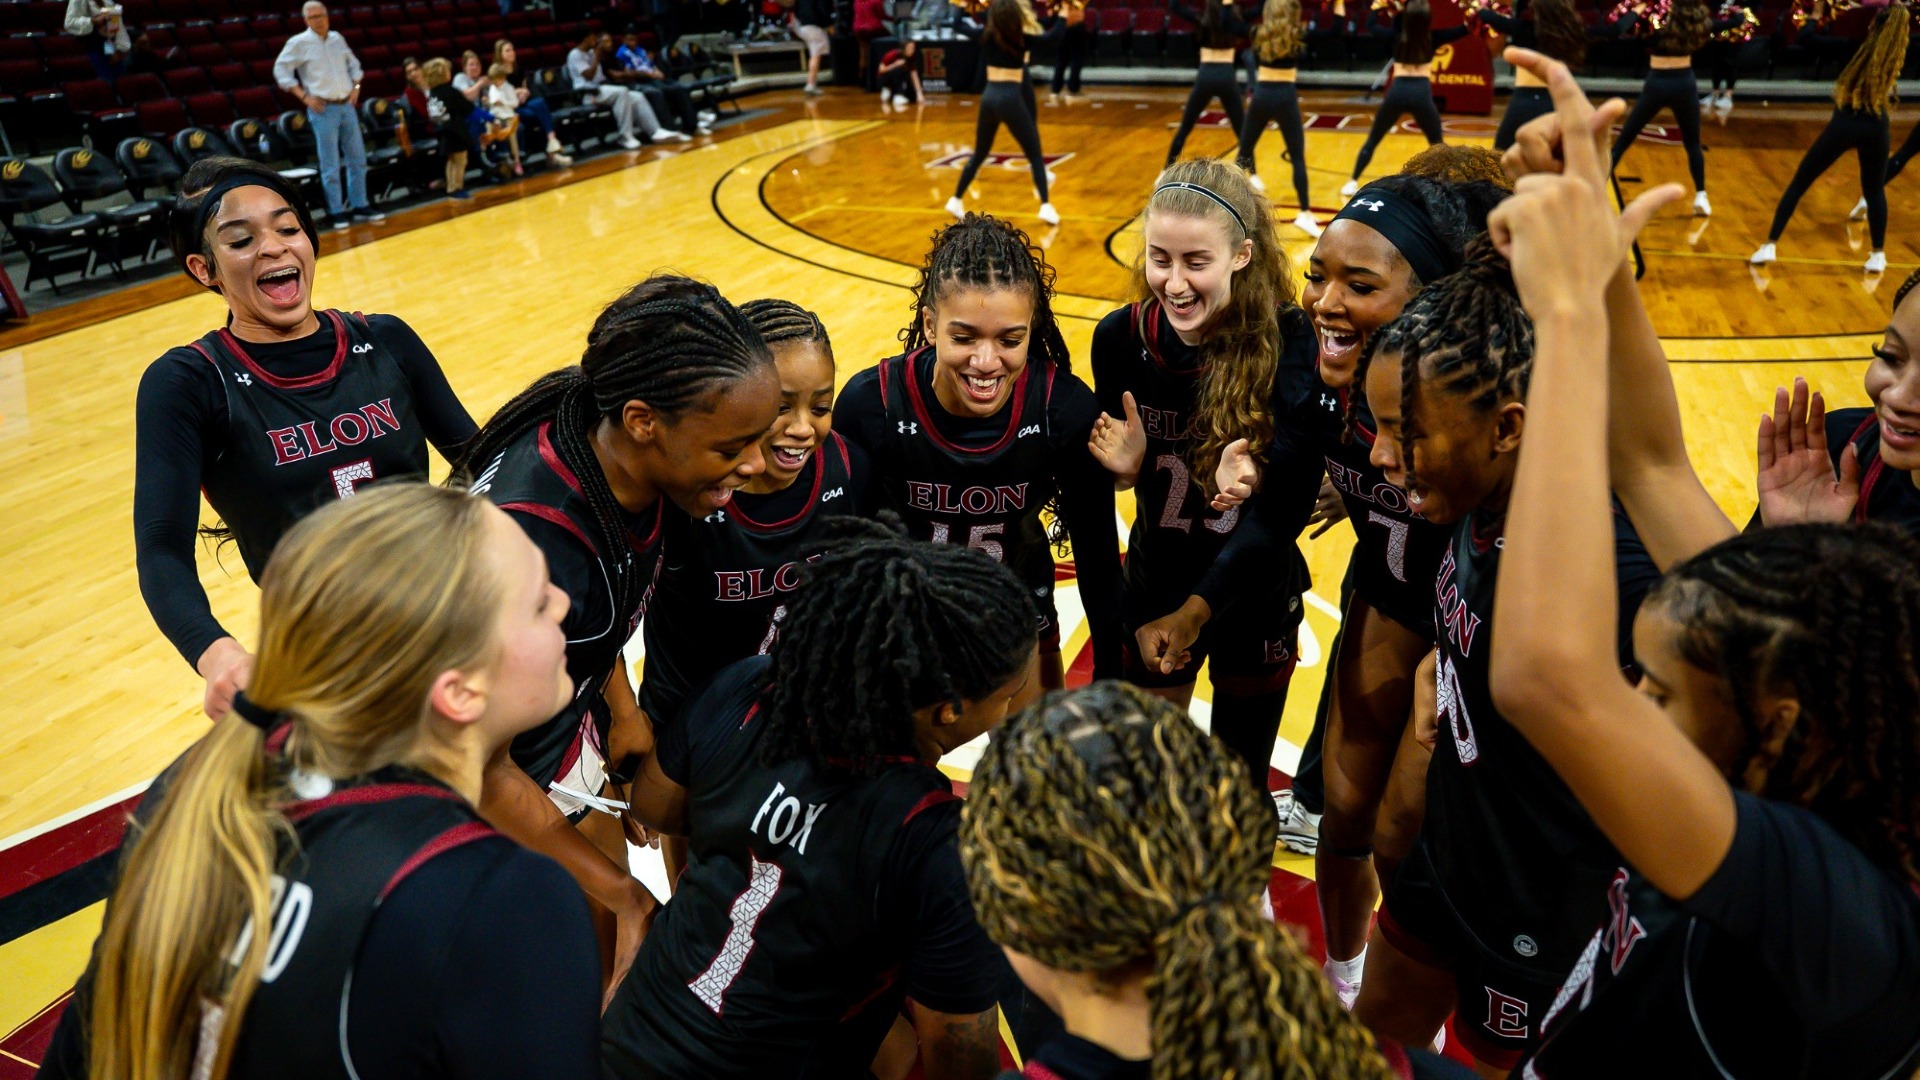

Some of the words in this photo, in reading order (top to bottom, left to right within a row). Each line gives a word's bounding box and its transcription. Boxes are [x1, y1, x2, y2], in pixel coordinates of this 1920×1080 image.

[922, 48, 946, 78] E
[1438, 73, 1486, 86] DENTAL
[266, 398, 400, 466] ELON
[1018, 424, 1040, 438] CAA
[1140, 404, 1212, 441] ELO
[822, 486, 844, 502] CAA
[906, 480, 1029, 515] ELON
[1324, 455, 1425, 520] ELO
[1368, 509, 1409, 583] 7
[714, 550, 824, 601] ELO
[750, 781, 828, 856] FOX
[688, 848, 784, 1018] 1
[1483, 985, 1528, 1039] E
